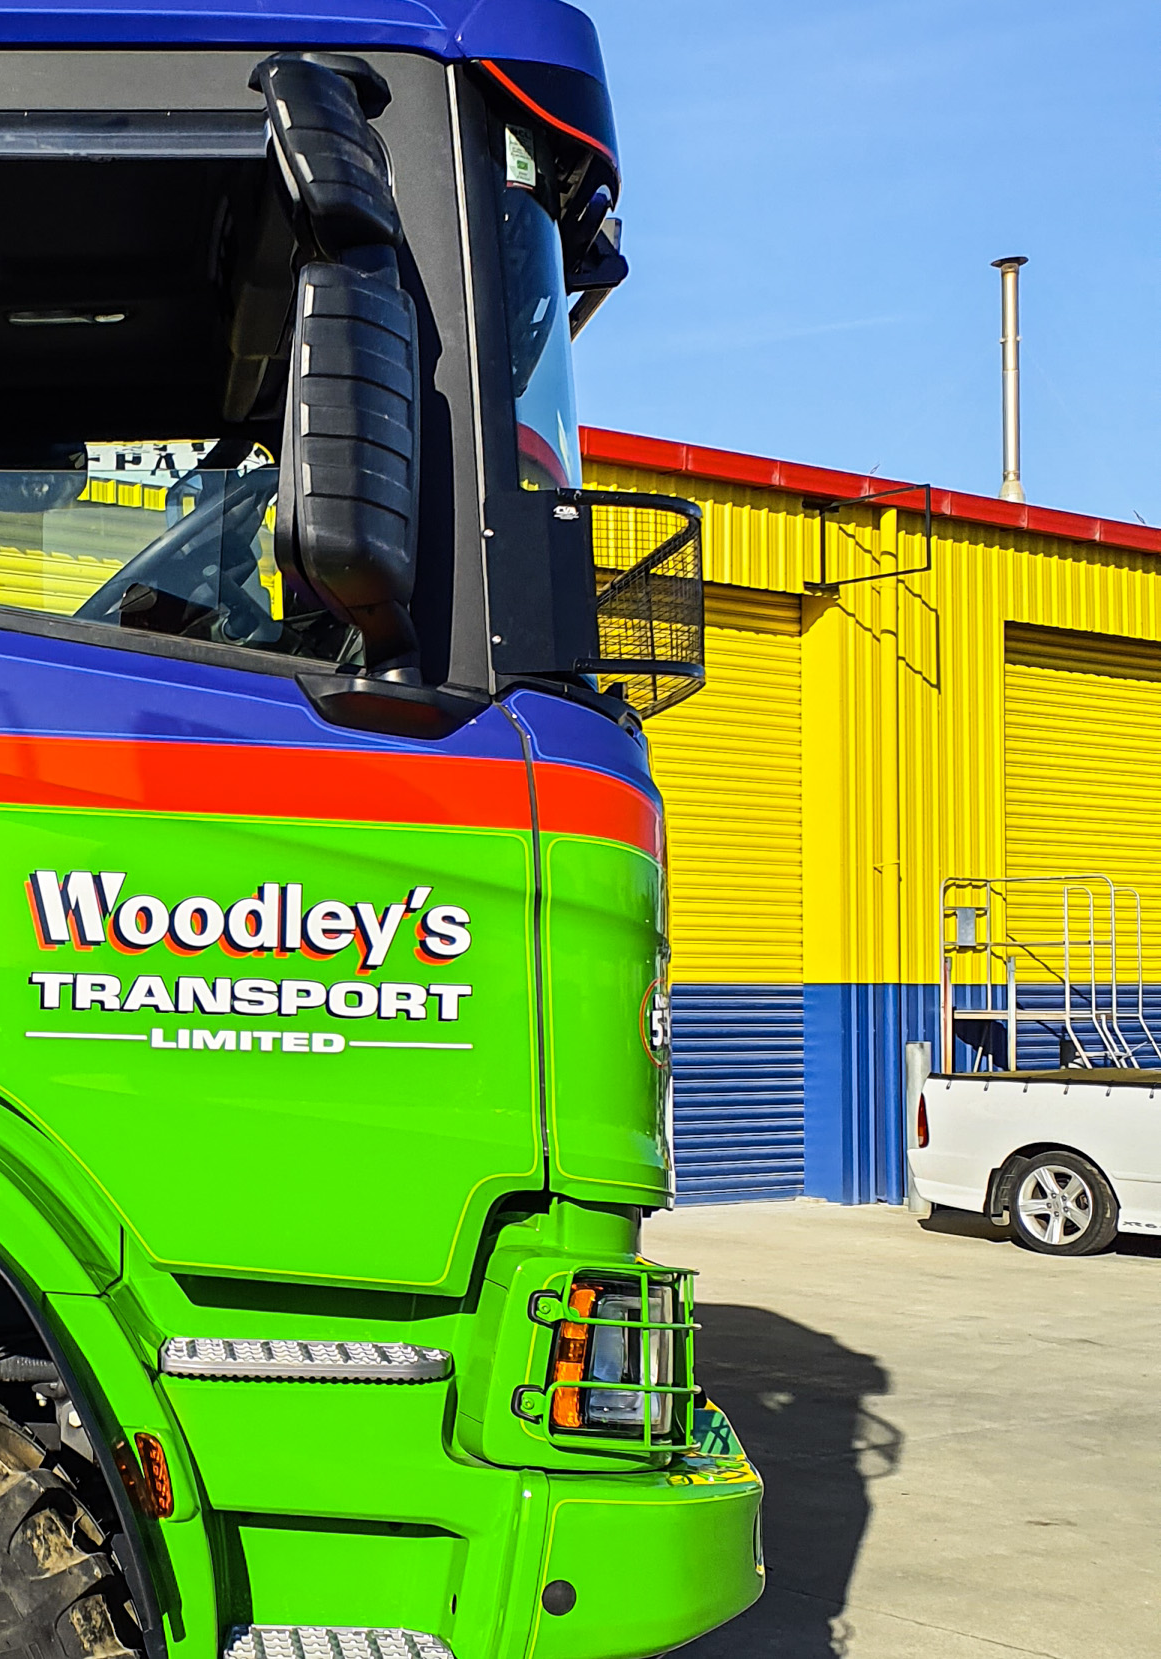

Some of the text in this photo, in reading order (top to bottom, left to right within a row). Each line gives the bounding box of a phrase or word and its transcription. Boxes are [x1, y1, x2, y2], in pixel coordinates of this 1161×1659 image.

[25, 869, 473, 976] Woodley's
[29, 972, 473, 1021] TRANSPORT
[150, 1027, 346, 1054] LIMITED
